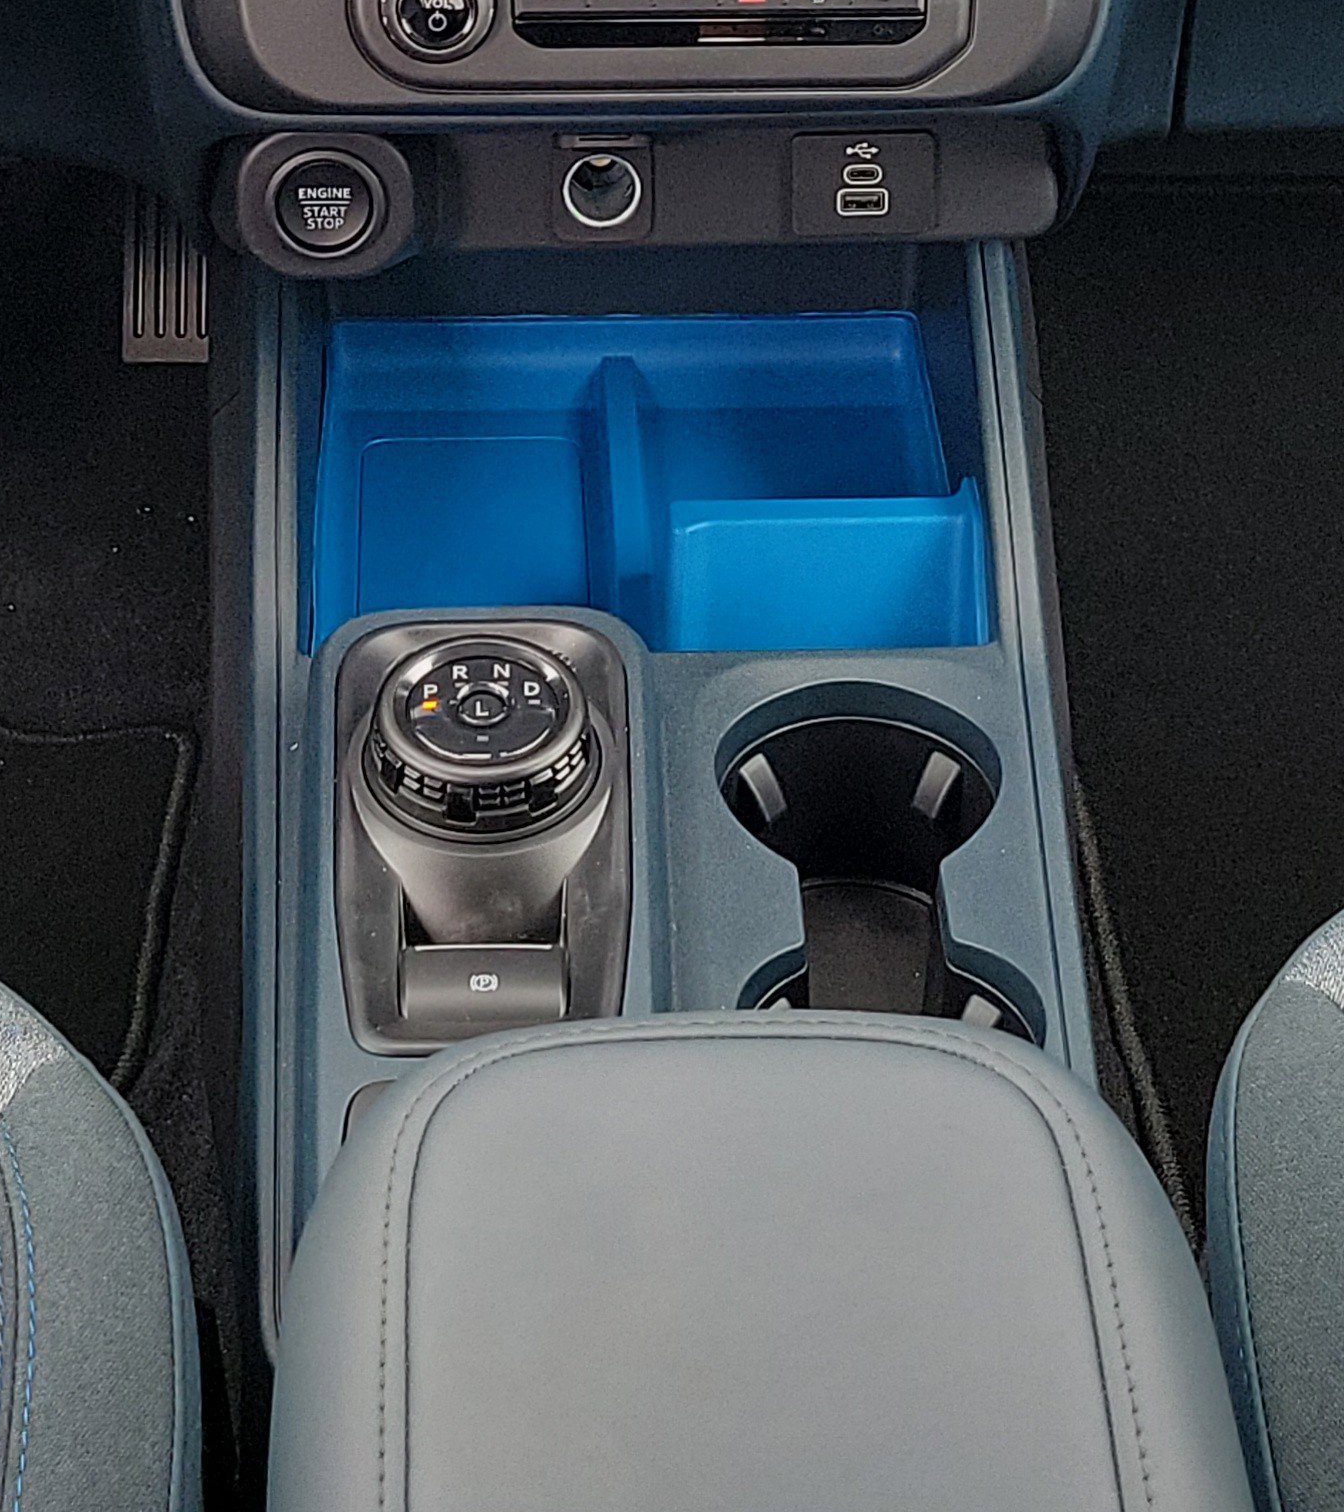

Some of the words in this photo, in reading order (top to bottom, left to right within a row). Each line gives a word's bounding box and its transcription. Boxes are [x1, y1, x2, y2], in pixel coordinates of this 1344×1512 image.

[298, 187, 352, 199] ENGINE
[303, 206, 348, 218] START
[306, 217, 345, 230] STOP
[452, 665, 468, 680] R
[493, 663, 511, 678] N
[423, 684, 438, 699] P
[524, 682, 540, 698] D
[475, 701, 489, 718] L
